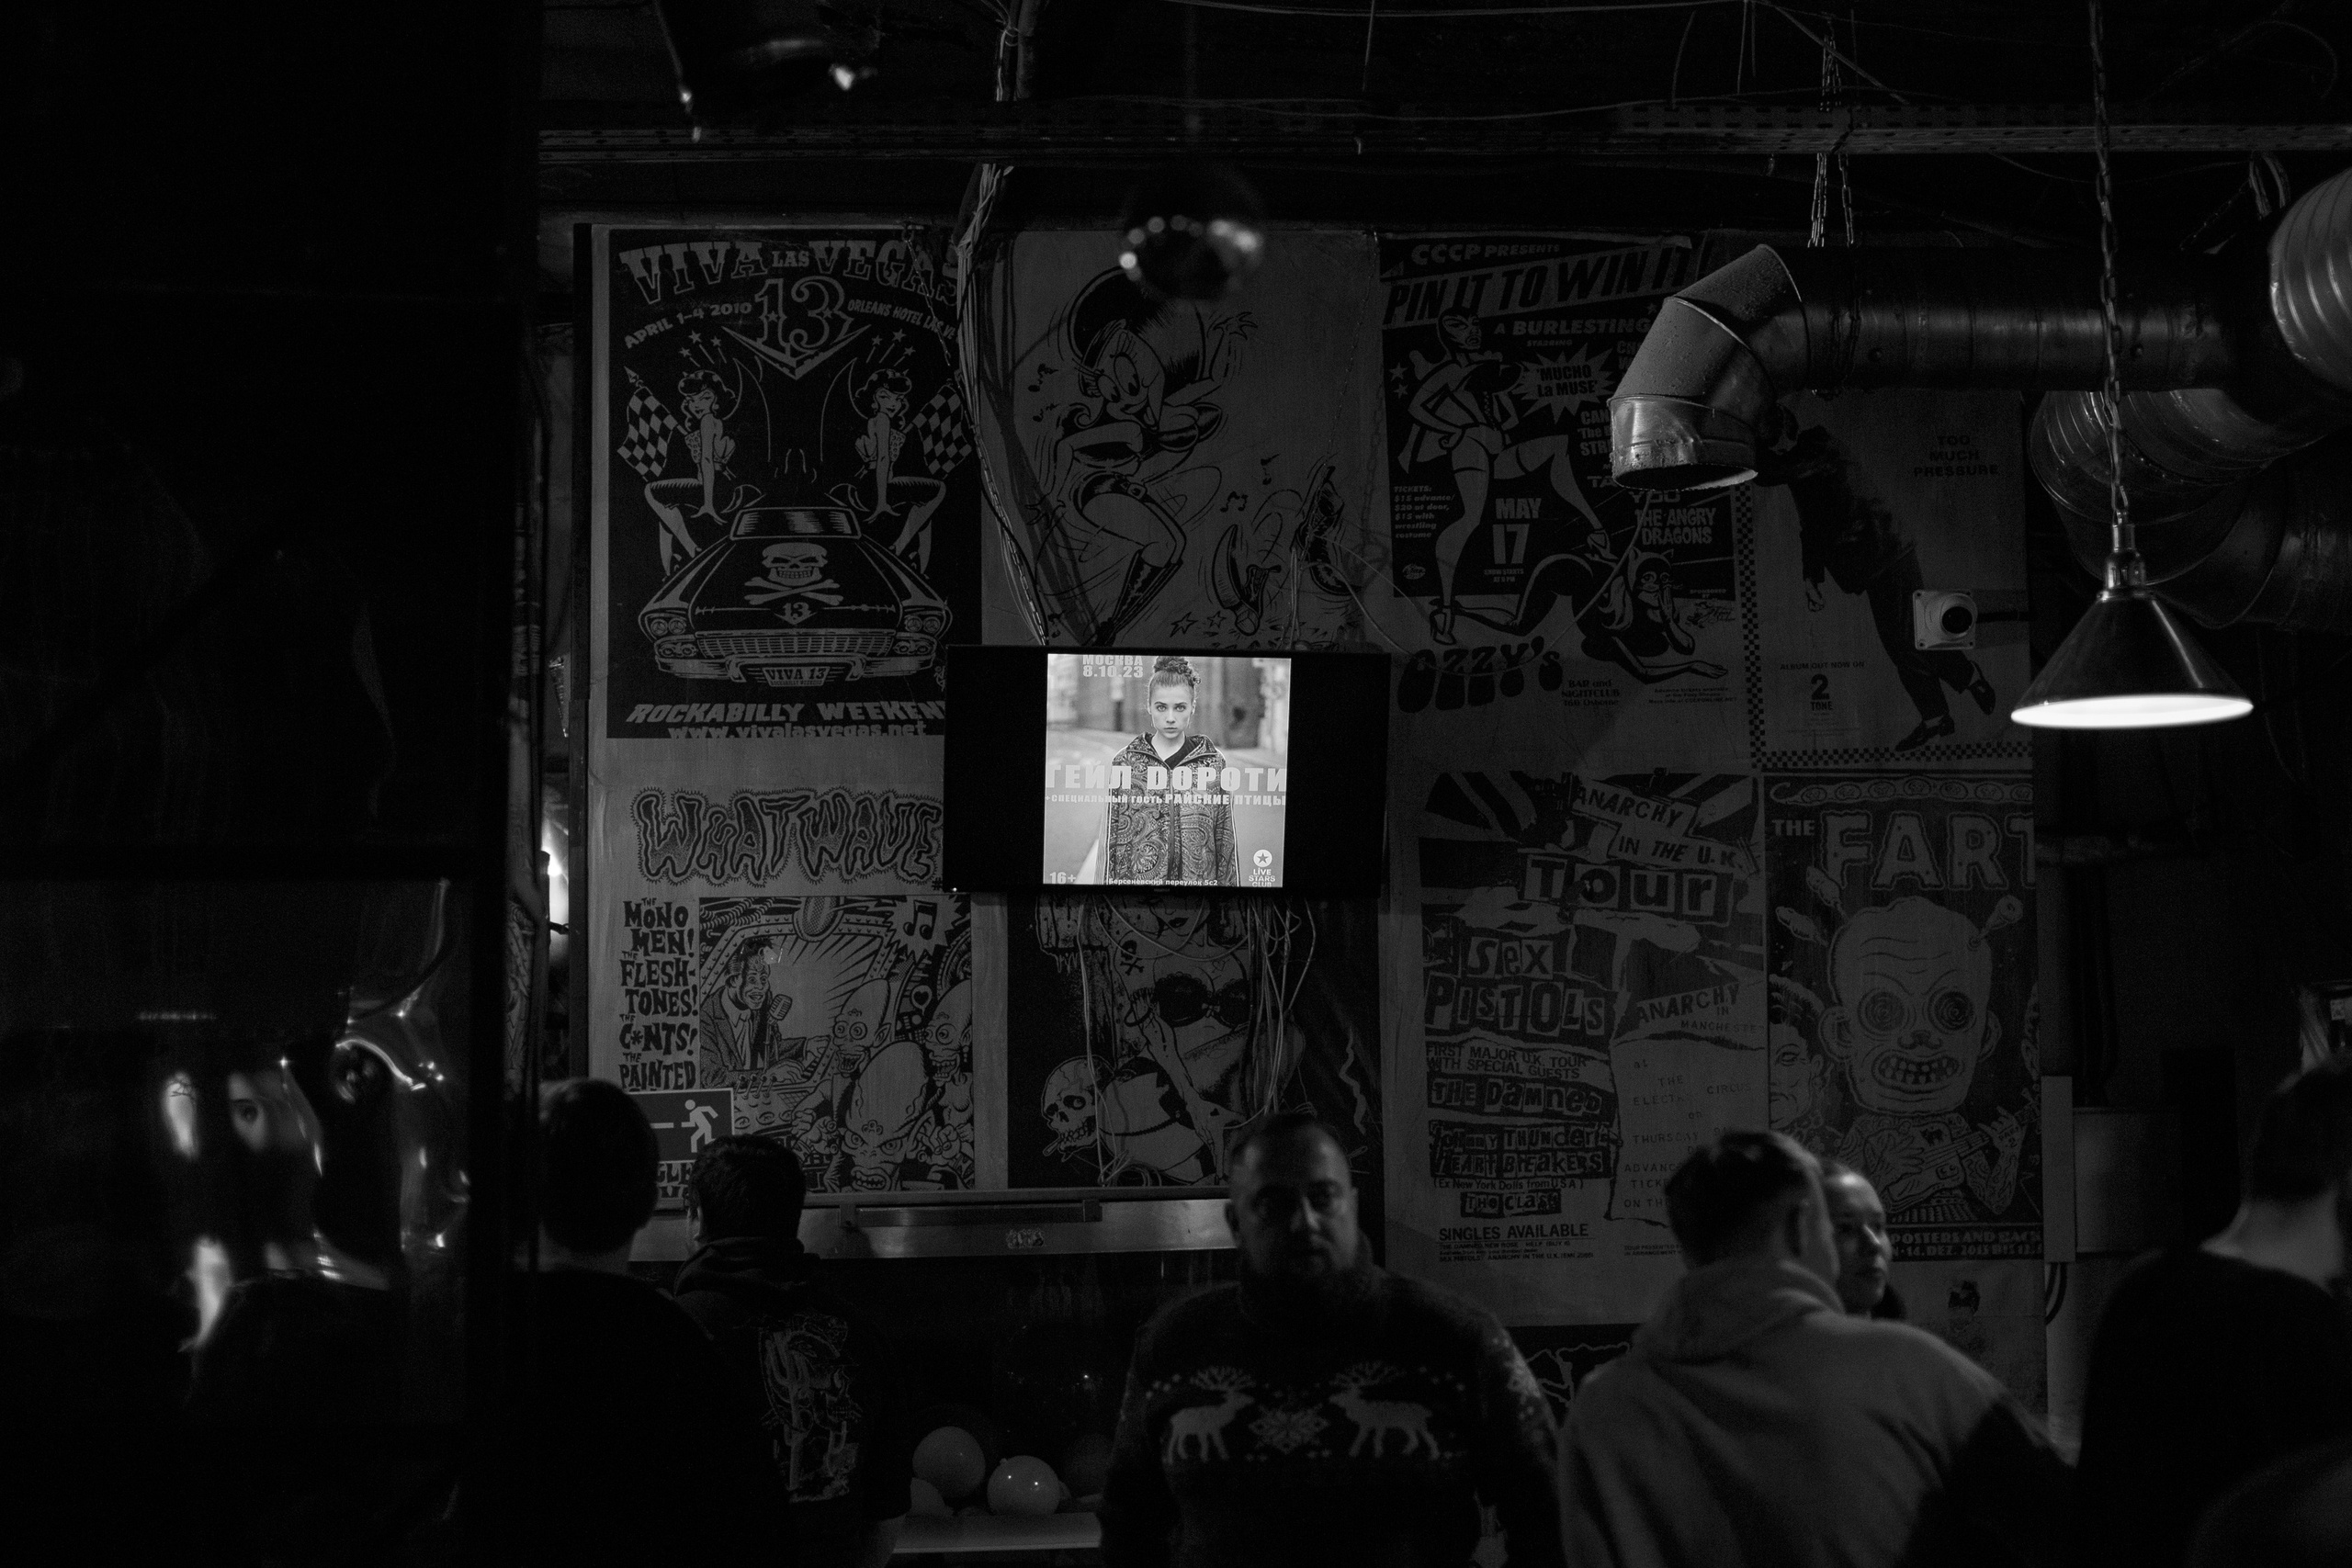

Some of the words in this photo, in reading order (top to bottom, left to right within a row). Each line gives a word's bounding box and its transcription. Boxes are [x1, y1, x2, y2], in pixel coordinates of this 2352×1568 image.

[1411, 244, 1481, 265] CCCP
[1484, 243, 1560, 258] PRESENTS
[618, 241, 768, 305] VIVA
[772, 250, 809, 267] LAS
[1383, 279, 1448, 325] PIN
[1452, 273, 1494, 314] IT
[1498, 265, 1549, 311] TO
[1557, 251, 1649, 302] WIN
[754, 276, 854, 351] 13
[847, 299, 892, 317] ORLEANS
[892, 305, 923, 325] HOTEL
[922, 315, 944, 333] LAS
[624, 318, 673, 349] APRIL
[676, 308, 705, 324] 1-4
[709, 301, 752, 316] 2010
[1494, 323, 1506, 334] A
[1527, 339, 1573, 347] STARRING
[1536, 364, 1592, 381] 'MUCHO
[1537, 384, 1553, 397] La
[1937, 435, 1971, 446] TOO
[1928, 449, 1980, 461] MUCH
[1914, 465, 1999, 478] PRESSURE
[1496, 498, 1543, 519] MAY
[1634, 509, 1662, 527] THE
[1666, 508, 1716, 526] ANGRY
[1492, 524, 1530, 564] 17
[1641, 527, 1713, 545] DRAGONS
[782, 602, 812, 622] 13
[1083, 655, 1143, 666] МОСКВА
[764, 669, 804, 680] VIVA
[808, 668, 826, 679] 13
[1083, 665, 1144, 678] 8.10.23
[1568, 680, 1590, 688] BAR
[1811, 673, 1830, 701] 2
[1561, 689, 1620, 697] NIGHTCLUB
[626, 703, 805, 723] ROCKABILLY
[817, 701, 944, 721] WEEKEN
[1810, 701, 1834, 711] TONE
[1577, 785, 1685, 829] ANARCHY
[1771, 819, 1815, 836] THE
[636, 792, 811, 884] WHAT
[797, 793, 943, 884] WAVE
[1618, 836, 1640, 855] IN
[1654, 840, 1689, 862] THE
[1049, 872, 1077, 884] 16+
[1165, 878, 1203, 886] переулок
[641, 897, 657, 907] THE
[623, 900, 689, 929] MONO
[630, 928, 695, 958] MEN!
[621, 951, 638, 960] THE
[619, 957, 695, 988] FLESH-
[625, 984, 698, 1017] TONES!
[1636, 984, 1739, 1023] ANARCHY
[619, 1013, 636, 1022] THE
[1716, 1007, 1729, 1016] IN
[623, 1052, 641, 1063] THE
[1426, 1045, 1463, 1057] FIRST
[1470, 1045, 1517, 1061] MAJOR
[1550, 1056, 1588, 1068] TOUR
[618, 1059, 696, 1091] PAINTED
[1428, 1057, 1461, 1071] WITH
[1467, 1058, 1523, 1075] SPECIAL
[1529, 1065, 1580, 1079] GUESTS
[1657, 1074, 1684, 1087] THE
[1706, 1083, 1752, 1095] CIRCUS
[1433, 1081, 1476, 1106] THE
[1453, 1179, 1474, 1190] New
[1476, 1179, 1497, 1191] York
[1498, 1179, 1524, 1190] Dolls
[1526, 1179, 1550, 1190] from
[1623, 1198, 1641, 1208] ON
[1439, 1226, 1501, 1241] SINGLES
[1507, 1224, 1589, 1238] AVAILABLE
[1890, 1232, 1961, 1244] POSTERS
[1962, 1230, 1996, 1243] AND
